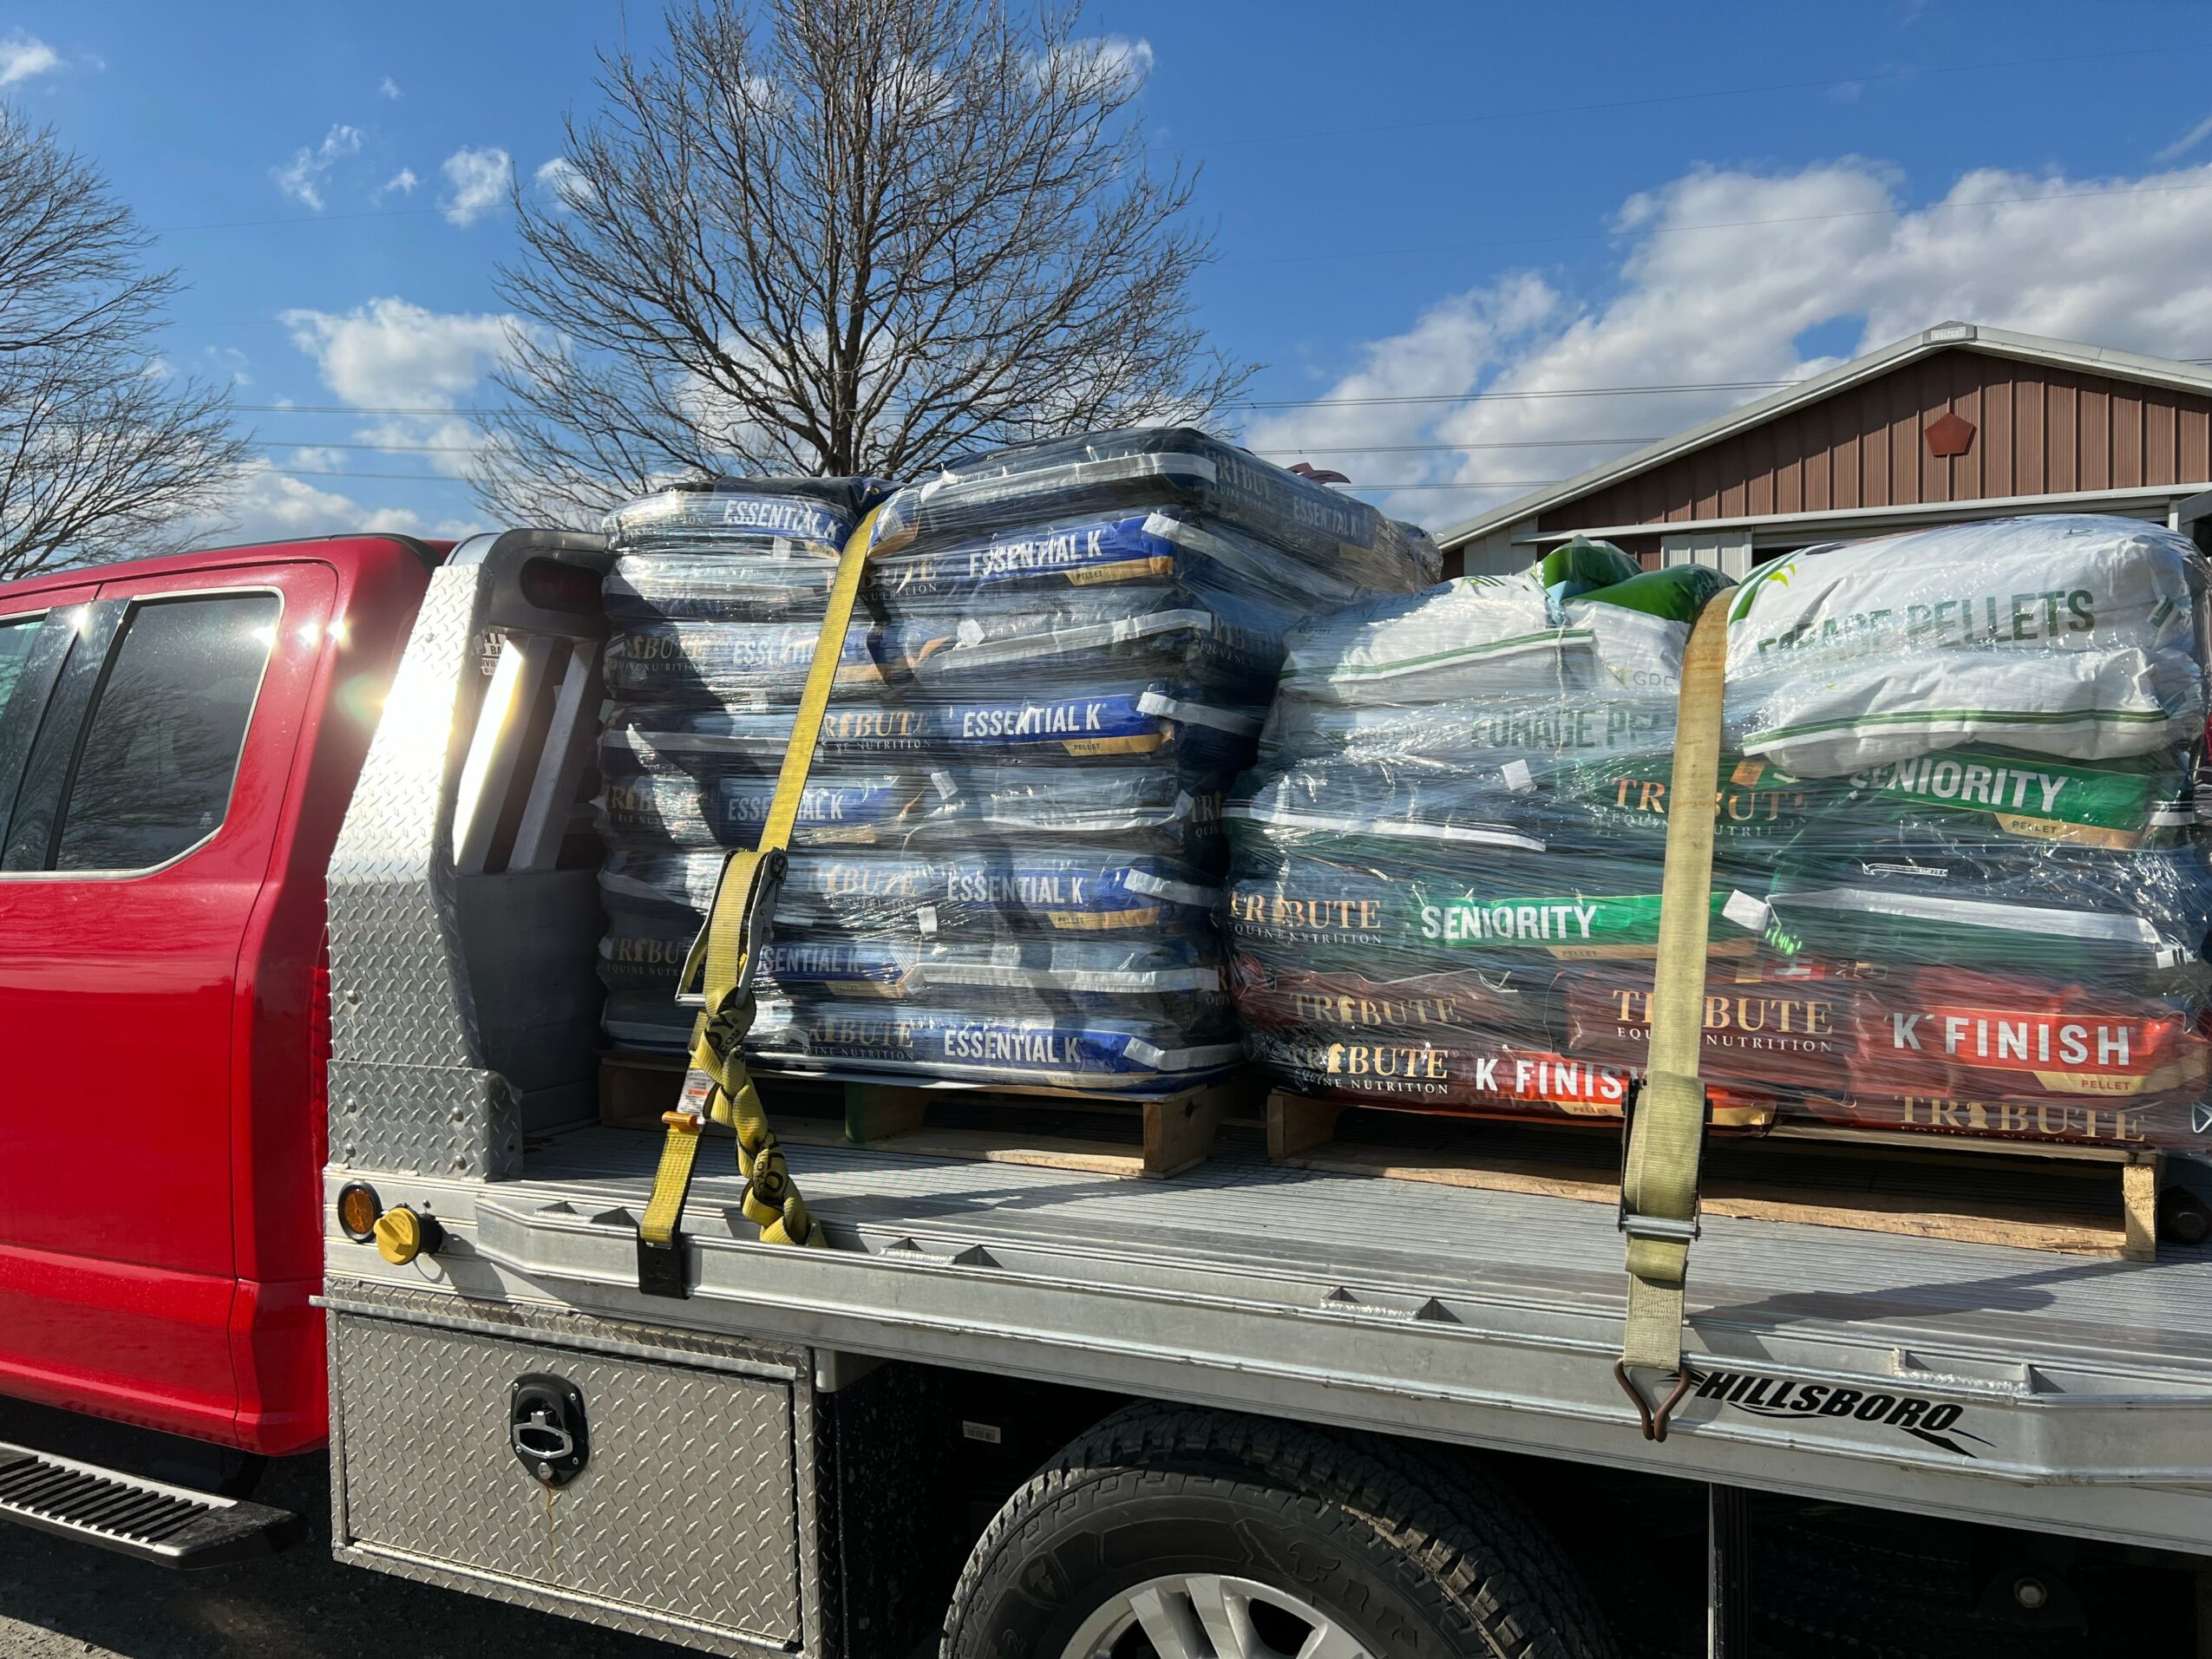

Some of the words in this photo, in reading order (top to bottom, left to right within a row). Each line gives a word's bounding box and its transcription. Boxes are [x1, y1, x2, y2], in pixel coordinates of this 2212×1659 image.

[969, 534, 1077, 578] ESSENTIAL
[1086, 530, 1103, 558] K
[1076, 569, 1103, 581] PELLET
[963, 704, 1080, 737] ESSENTIAL
[1086, 702, 1102, 729] K
[1073, 742, 1101, 751] PELLET
[1849, 756, 2068, 813] SENIORITY
[830, 794, 843, 820] K
[2012, 820, 2058, 833] PELLET
[947, 873, 1065, 904] ESSENTIAL
[1071, 875, 1083, 905] K
[1422, 905, 1597, 939] SENIORITY
[841, 1048, 913, 1061] NUTRITION
[945, 1030, 1061, 1064] ESSENTIAL
[1065, 1035, 1080, 1064] K
[1706, 1034, 1833, 1053] NUTRITION
[1894, 1013, 1922, 1050] K
[1945, 1017, 2130, 1066] FINISH
[1351, 1079, 1449, 1094] NUTRITION
[1476, 1056, 1498, 1092] K
[1515, 1058, 1638, 1100] FINIS
[2082, 1080, 2130, 1091] PELLET
[1693, 1371, 1965, 1431] HILLSBORO
